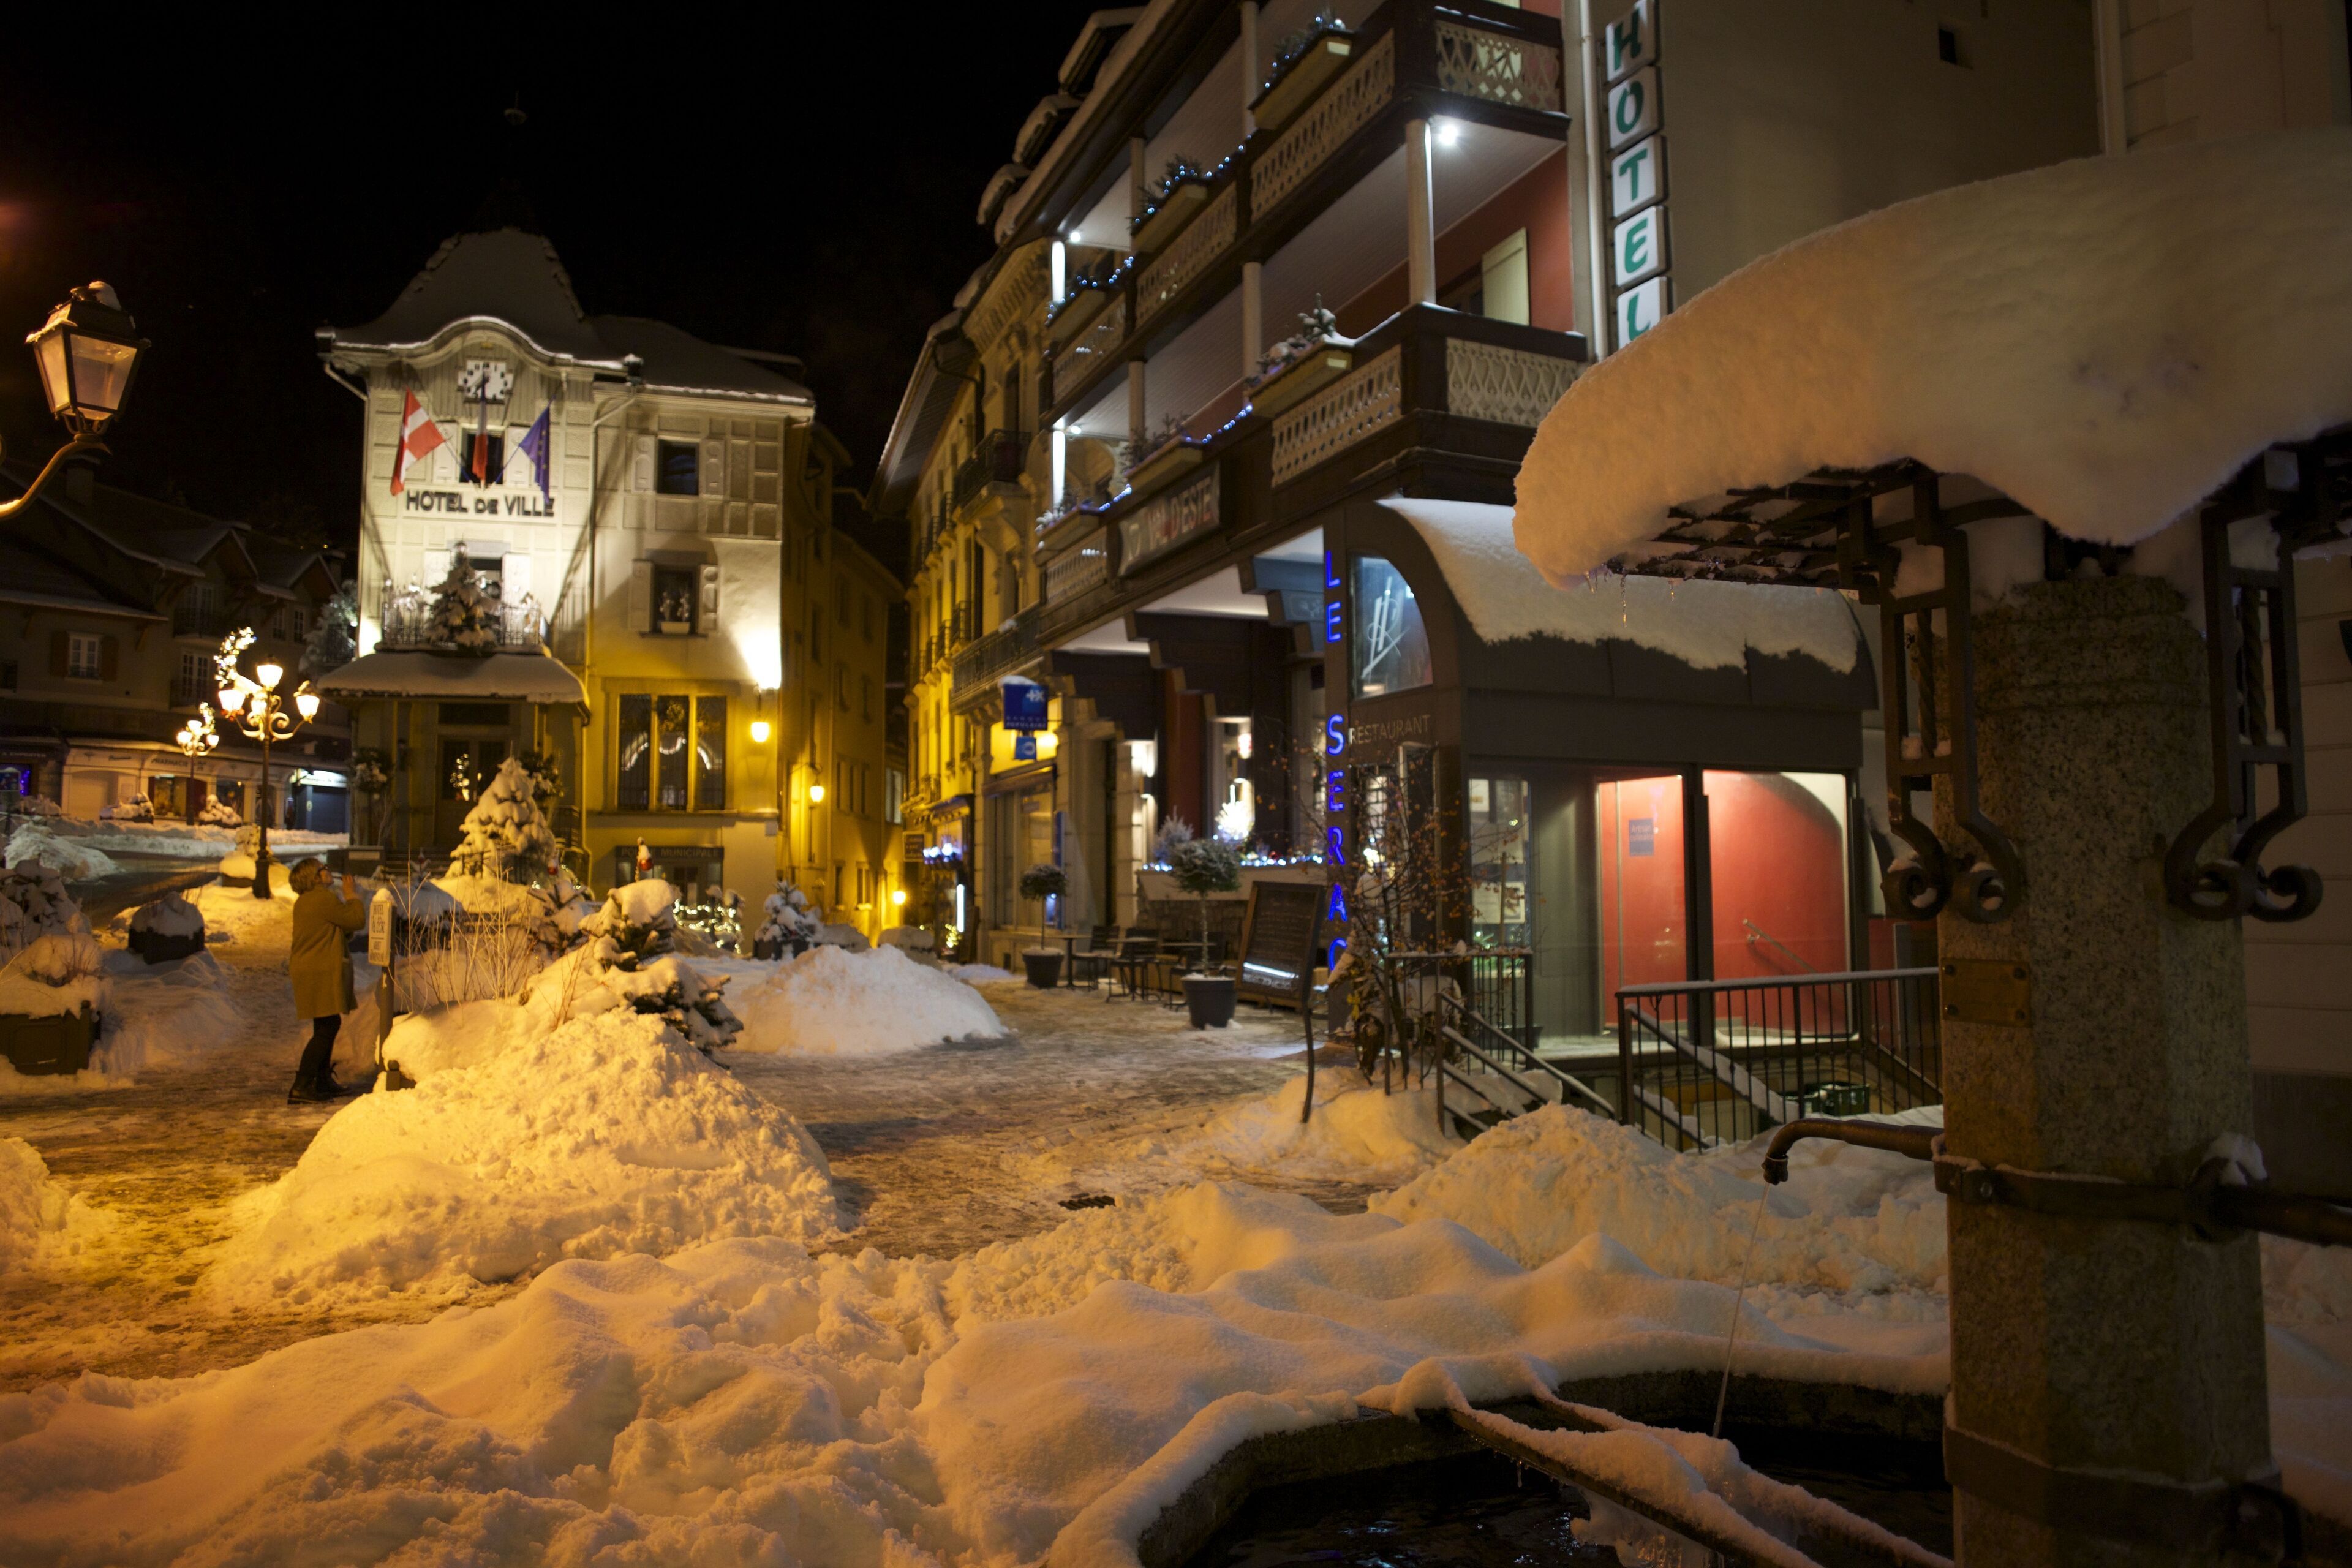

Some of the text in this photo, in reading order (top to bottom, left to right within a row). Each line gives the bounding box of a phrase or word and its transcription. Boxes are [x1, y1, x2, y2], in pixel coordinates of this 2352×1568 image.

[1612, 7, 1650, 341] HOTEL
[475, 498, 498, 514] DE
[504, 494, 555, 517] VILLE
[1325, 550, 1342, 642] LE
[1348, 714, 1431, 745] RESTAURANT
[151, 757, 189, 767] PHARMACIE
[660, 847, 718, 858] MUNICIPALE
